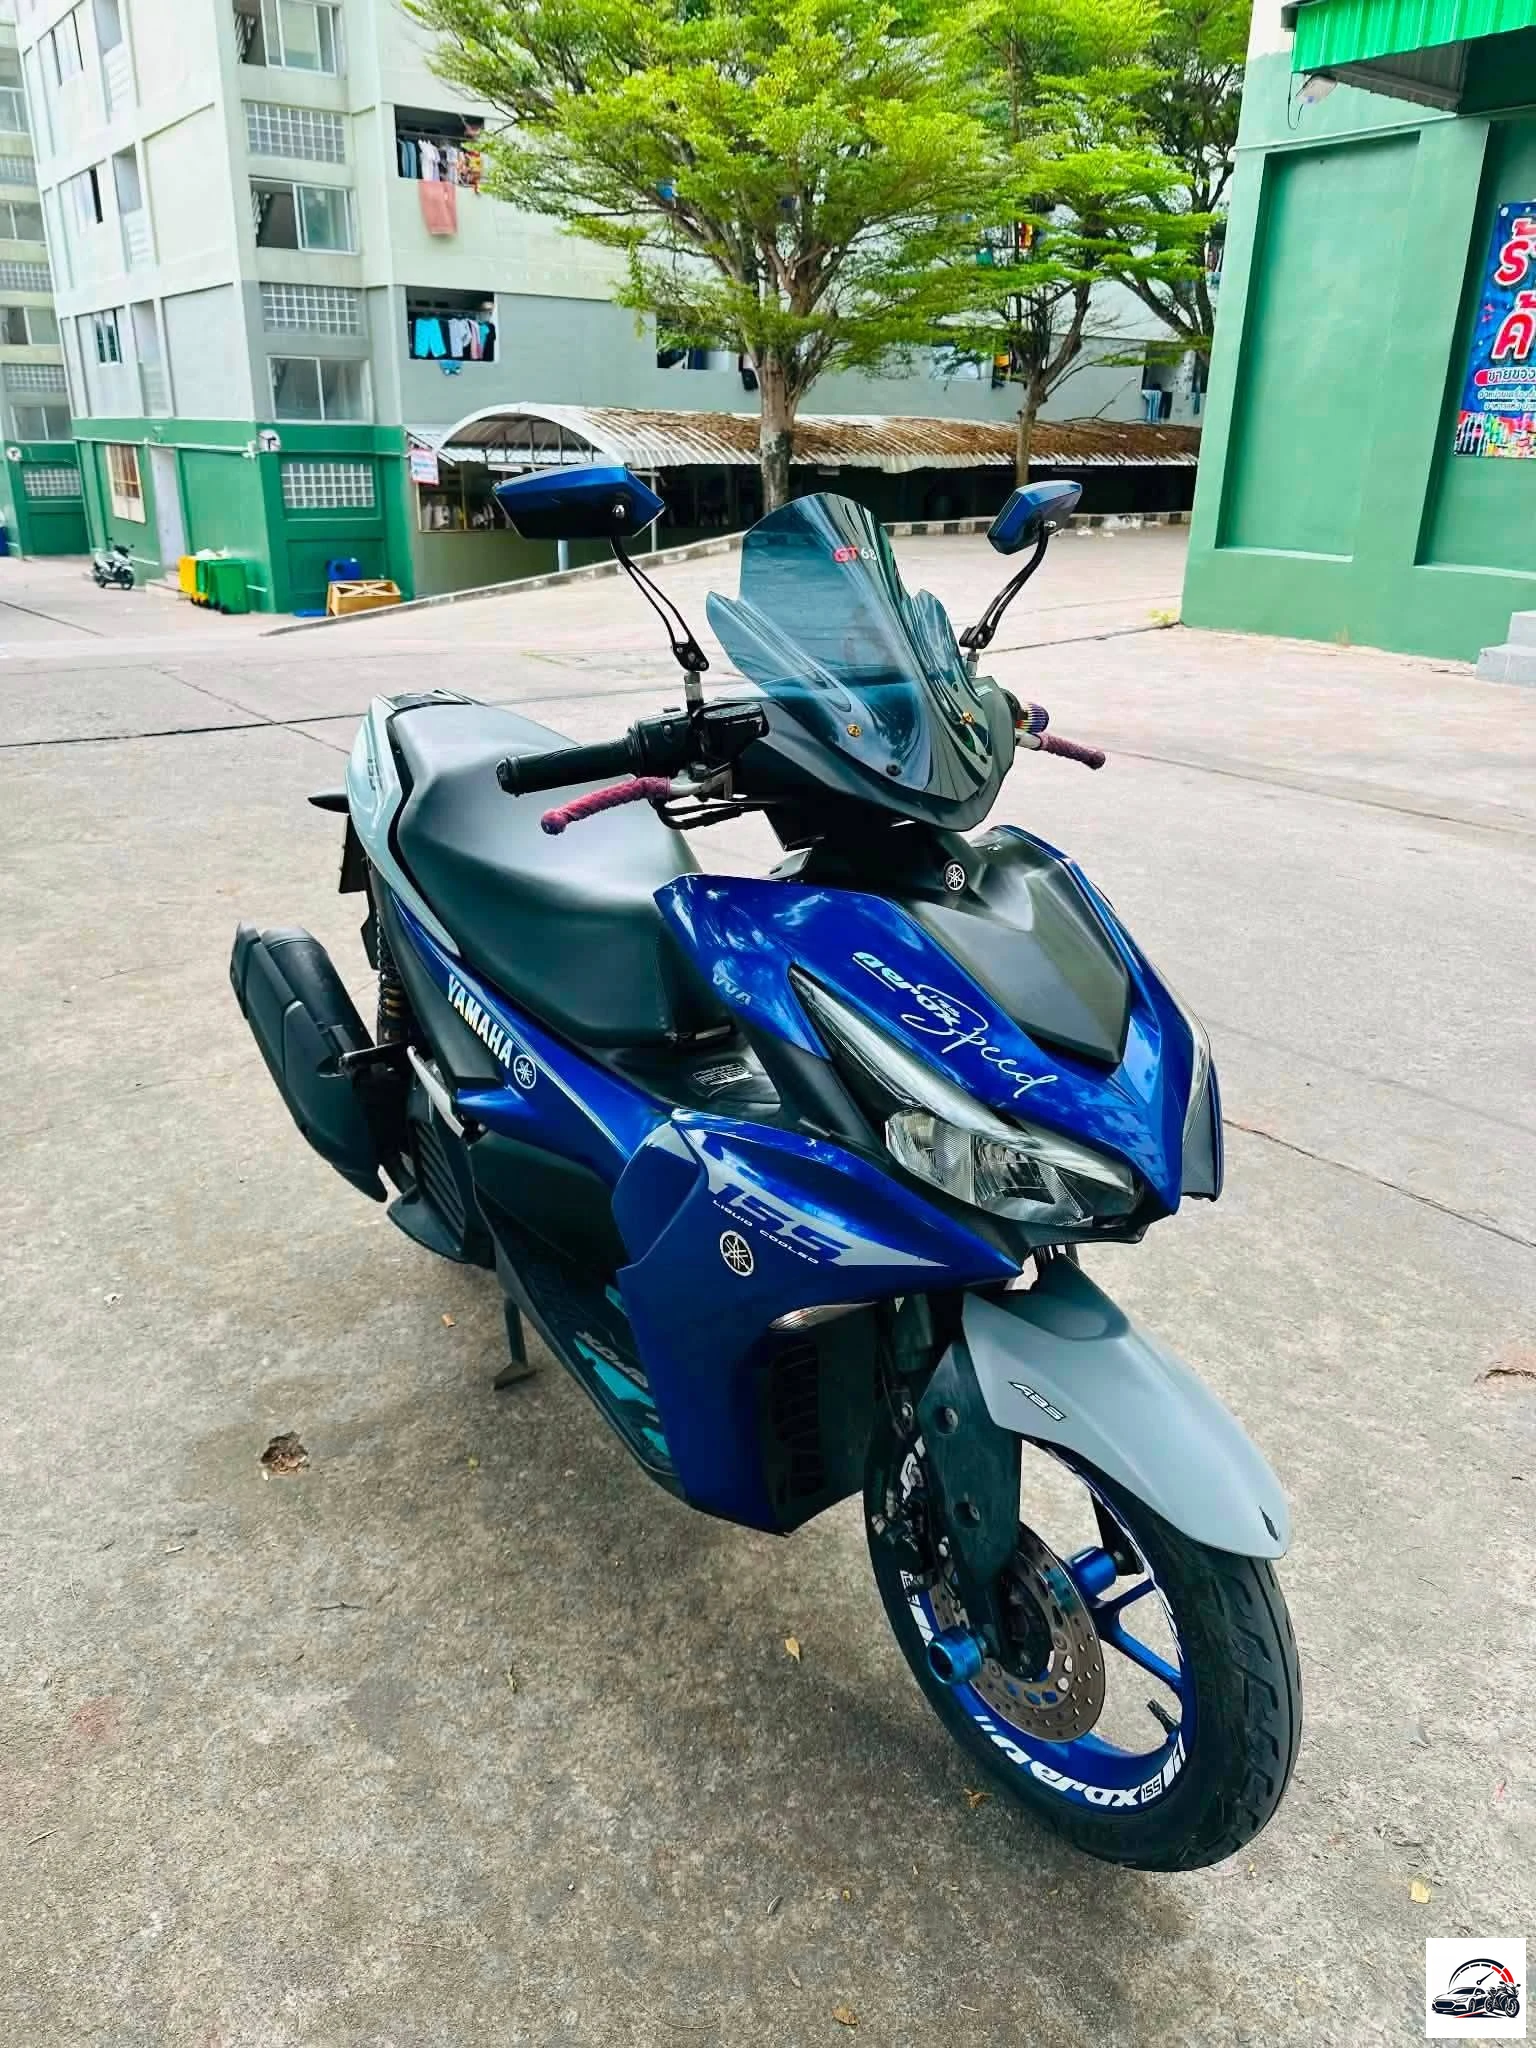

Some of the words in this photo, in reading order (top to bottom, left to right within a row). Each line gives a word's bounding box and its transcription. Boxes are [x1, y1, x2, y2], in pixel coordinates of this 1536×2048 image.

[833, 545, 857, 563] GT
[448, 974, 514, 1068] YAMAHA
[901, 984, 1058, 1098] Speed
[712, 1199, 753, 1227] LIQUID
[759, 1229, 819, 1264] COOLED
[714, 1183, 853, 1262] 155
[1008, 1381, 1066, 1421] ABS
[991, 1734, 1140, 1807] aerox
[1142, 1778, 1162, 1799] 155
